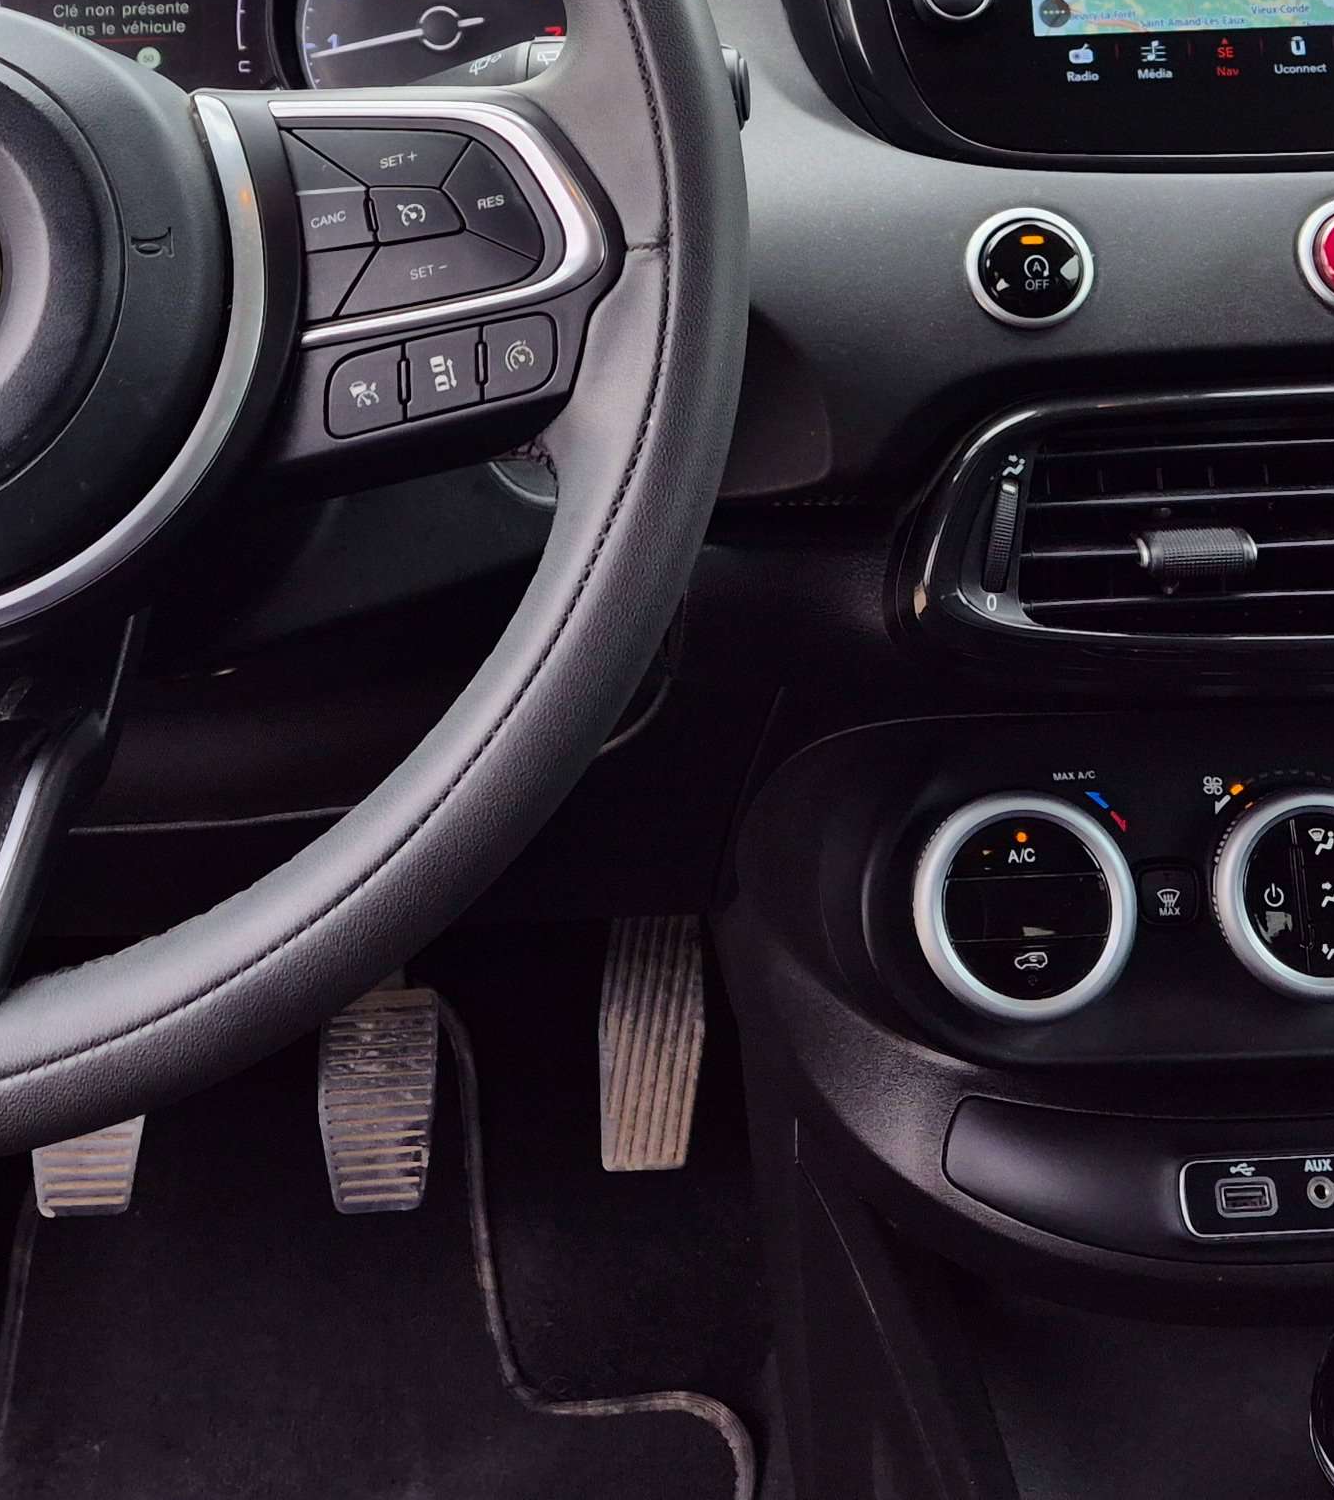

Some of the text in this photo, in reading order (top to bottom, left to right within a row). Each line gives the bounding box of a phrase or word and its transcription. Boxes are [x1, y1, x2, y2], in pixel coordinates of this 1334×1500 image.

[53, 1, 189, 18] Clé non présente
[102, 21, 116, 36] le
[122, 20, 187, 35] véhicule
[327, 34, 339, 49] 1
[1217, 47, 1234, 58] SE
[238, 59, 251, 73] C
[1217, 66, 1240, 77] Nav
[1273, 62, 1328, 74] Uconnect
[1067, 71, 1100, 83] Radio
[1137, 68, 1174, 80] Média
[379, 154, 404, 169] SET
[477, 194, 505, 210] RES
[310, 210, 347, 229] CANC
[409, 264, 435, 281] SET
[1024, 278, 1050, 291] OFF
[1052, 770, 1096, 781] MAX A/C
[1007, 847, 1036, 863] A/C
[1159, 907, 1181, 916] MAX
[1304, 1158, 1333, 1172] AUX
